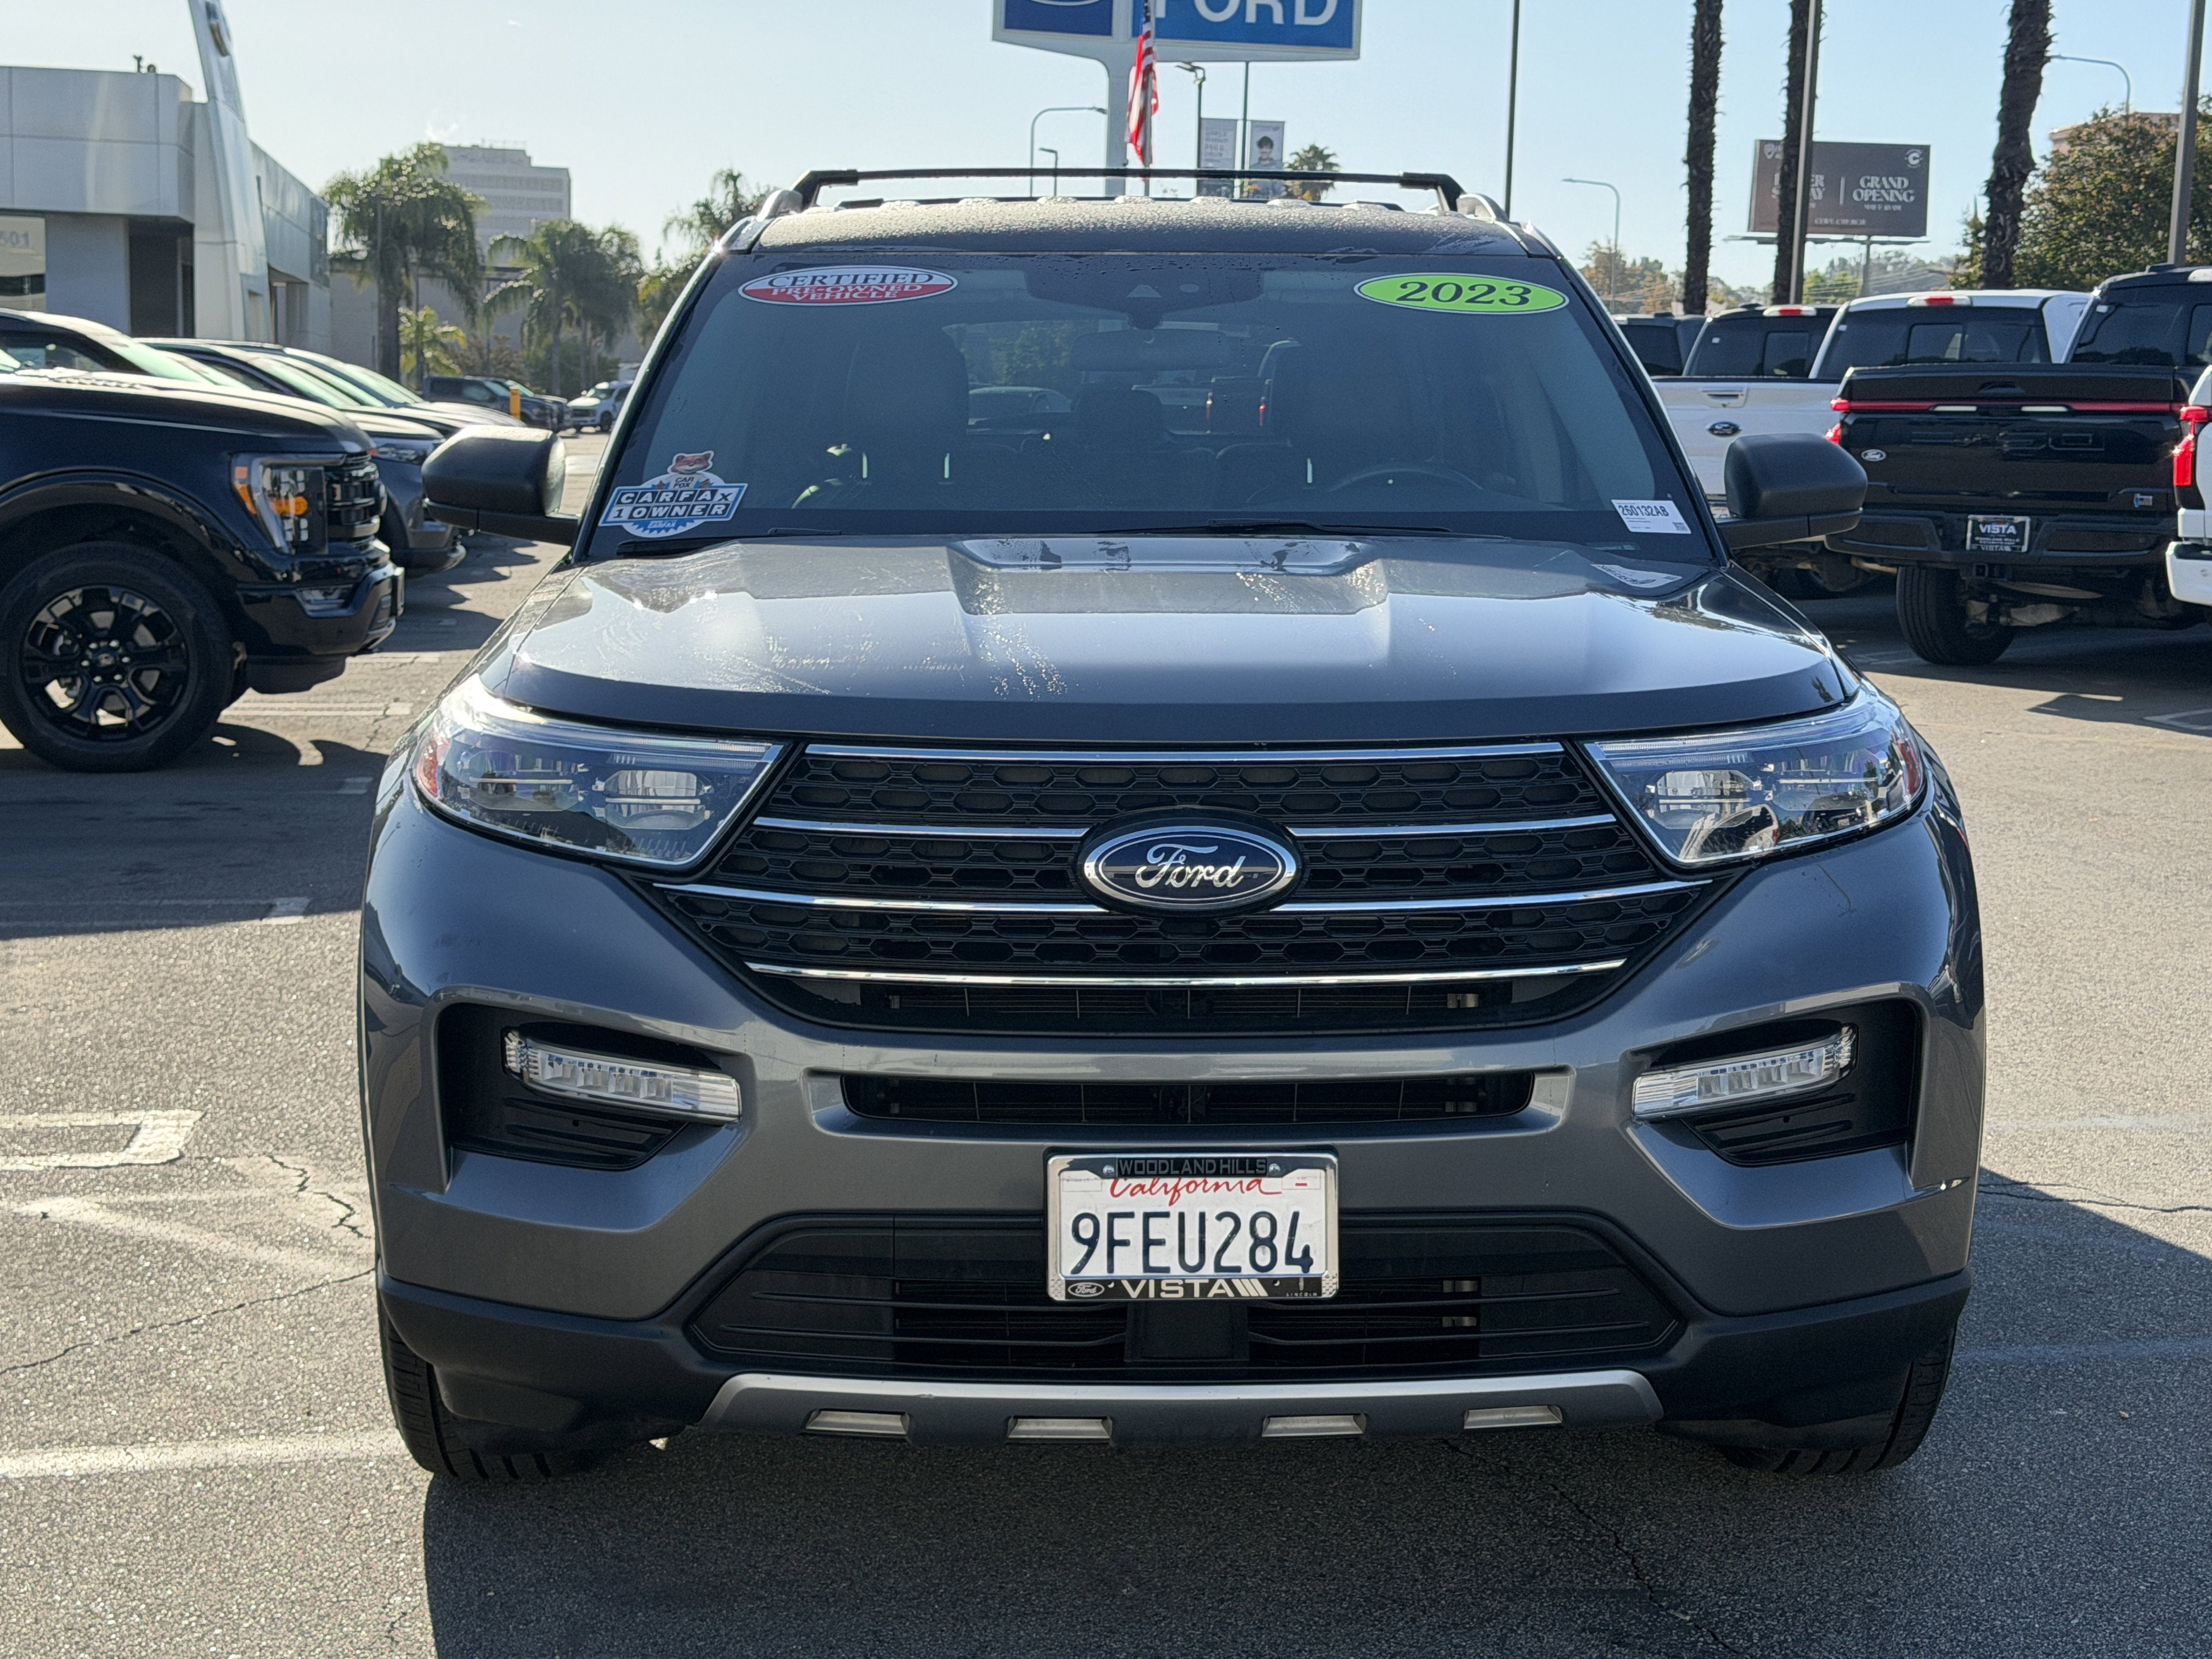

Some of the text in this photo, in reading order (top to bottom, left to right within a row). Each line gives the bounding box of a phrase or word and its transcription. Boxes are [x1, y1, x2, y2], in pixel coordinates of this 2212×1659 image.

[1859, 176, 1909, 189] GRAND
[1853, 188, 1915, 202] OPENING
[768, 273, 934, 287] CERTIFIED
[771, 285, 923, 296] PRE-OWNED
[792, 291, 899, 301] VEHICLE
[1396, 281, 1532, 306] 2023
[620, 490, 733, 504] CARFAX
[613, 504, 725, 519] 1 OWNER
[1979, 523, 2017, 535] VISTA
[1135, 843, 1246, 888] Ford
[1120, 1159, 1266, 1175] WOODLAND HILLS
[1110, 1177, 1282, 1206] California
[1070, 1211, 1314, 1274] 9FEU284
[1075, 1279, 1234, 1298] Ford VISTA
